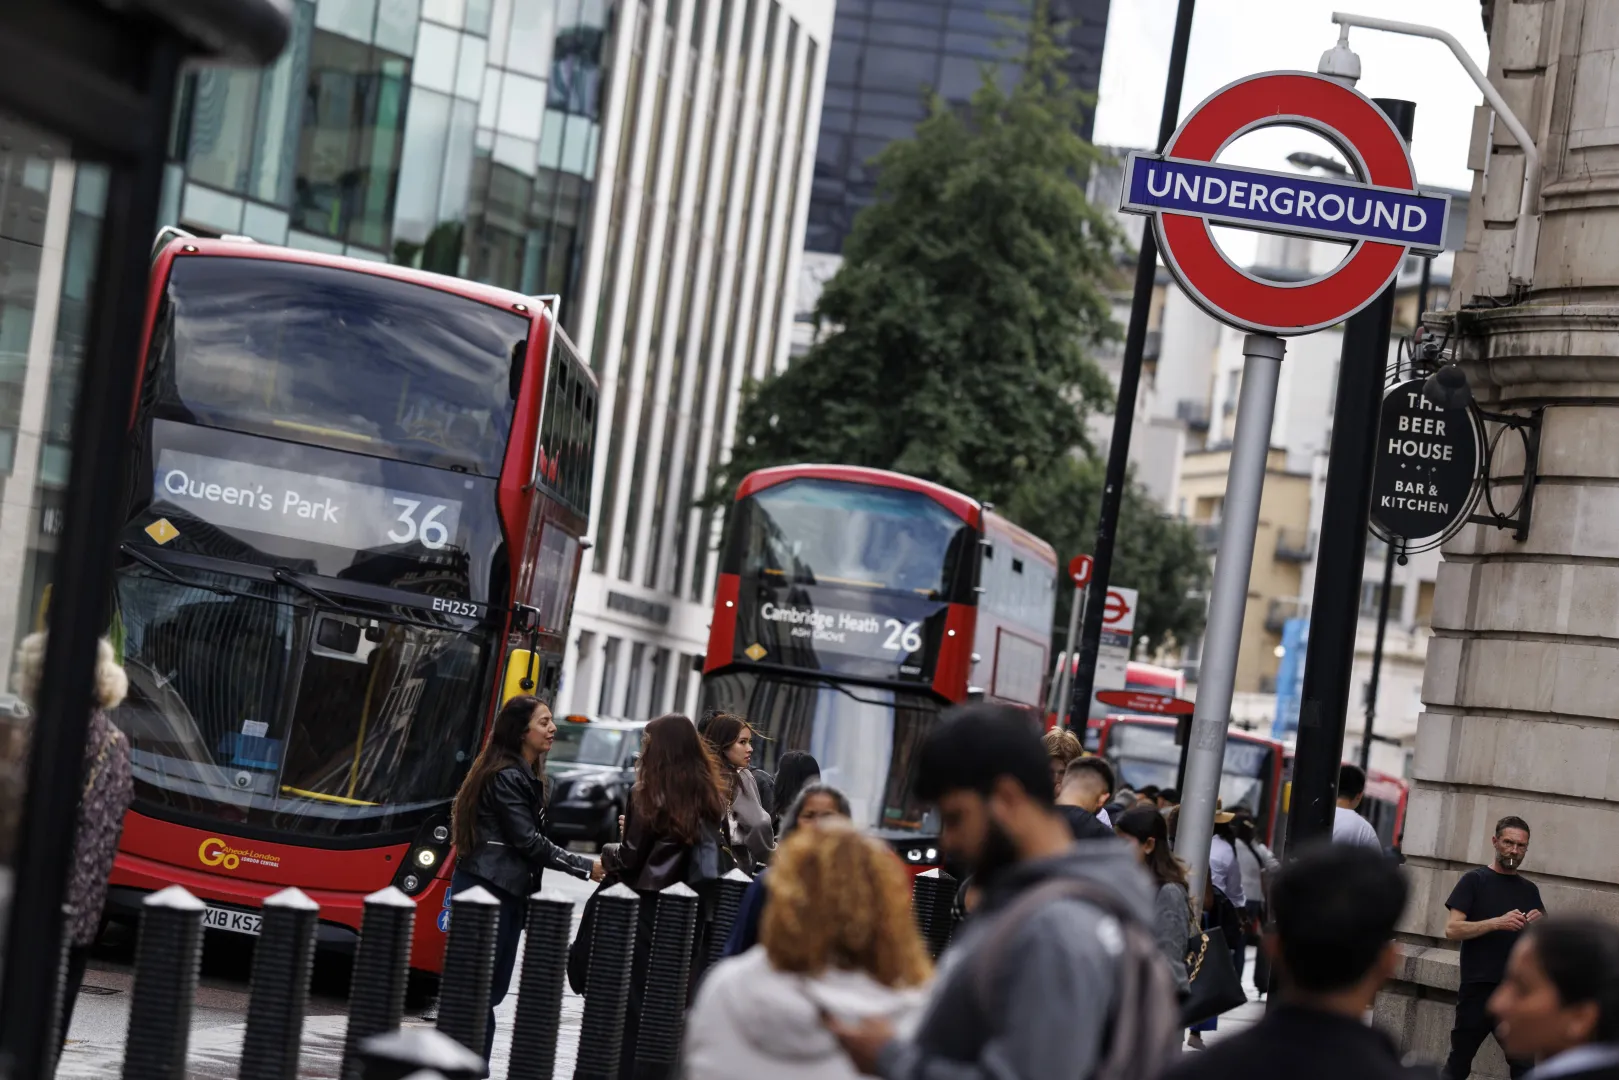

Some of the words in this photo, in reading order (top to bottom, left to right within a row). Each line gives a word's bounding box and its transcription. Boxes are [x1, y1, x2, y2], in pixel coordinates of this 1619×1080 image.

[1146, 168, 1427, 232] UNDERGROUND
[1407, 392, 1445, 412] TH
[1398, 415, 1446, 437] BEER
[1388, 438, 1453, 461] HOUSE
[164, 468, 273, 511] Queen's
[282, 489, 339, 525] Park
[1394, 480, 1425, 495] BAR
[1428, 484, 1439, 497] &
[1380, 495, 1449, 514] KITCHEN
[386, 497, 450, 550] 36
[1074, 559, 1088, 581] J
[432, 597, 478, 618] EH252
[760, 602, 834, 632] Cambridge
[838, 613, 880, 634] Heath
[881, 618, 922, 653] 26
[198, 837, 240, 870] Go
[260, 860, 280, 868] CENTRAL
